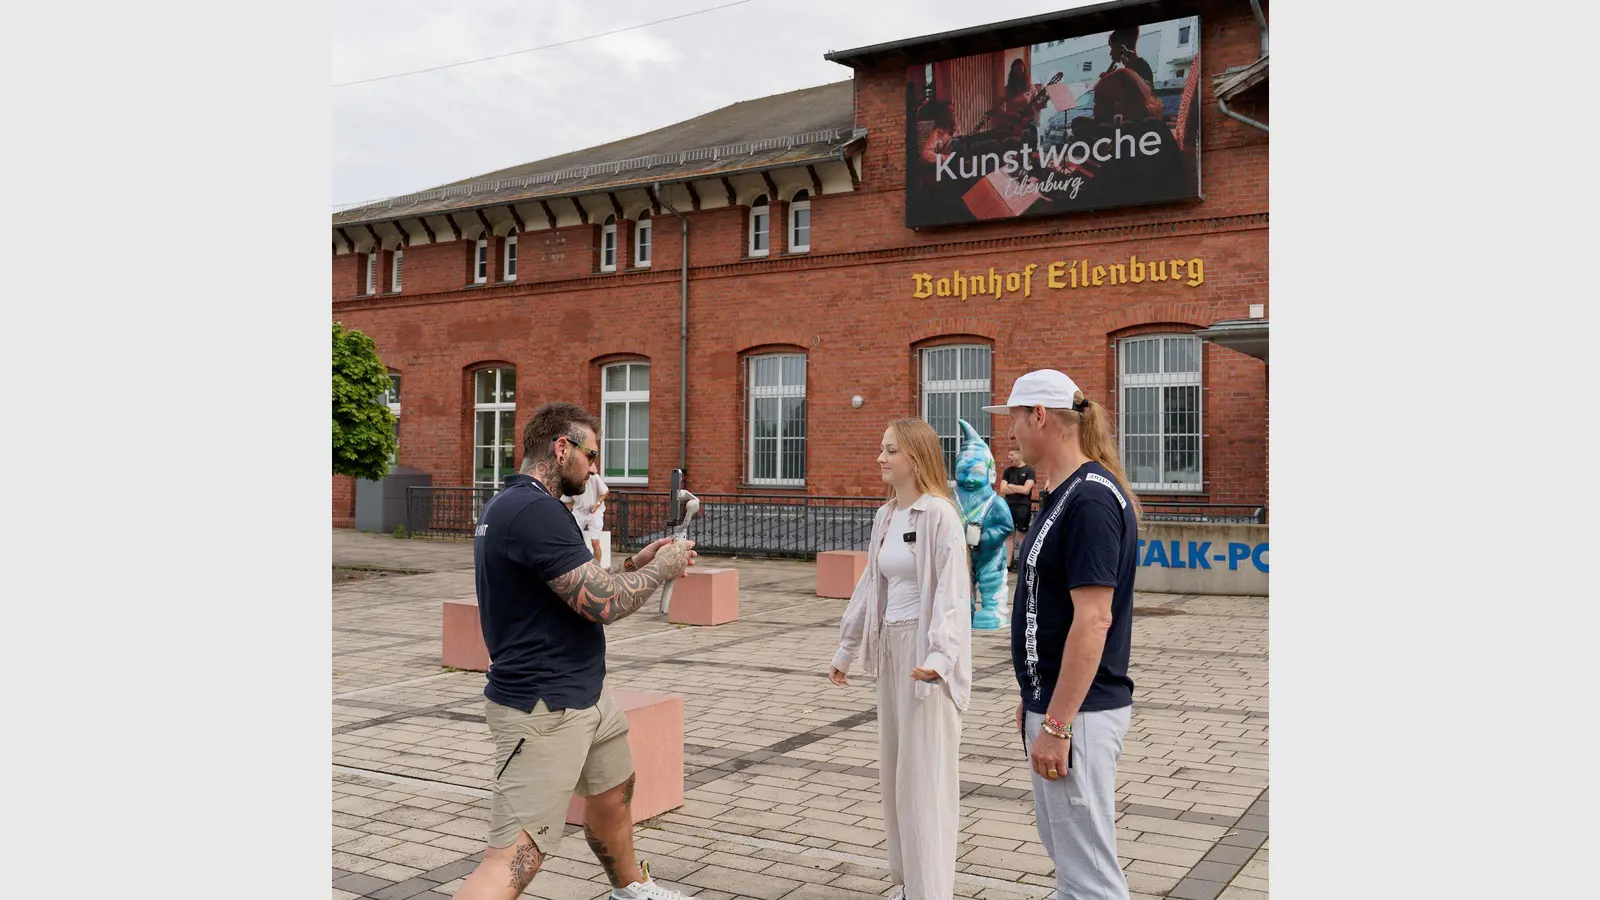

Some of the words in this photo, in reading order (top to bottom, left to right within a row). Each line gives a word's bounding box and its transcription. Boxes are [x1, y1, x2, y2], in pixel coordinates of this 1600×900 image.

[934, 128, 1163, 182] Kunstwoche
[1002, 172, 1085, 200] Eilenburg
[911, 263, 1038, 302] Bahnhof
[1047, 255, 1206, 289] Eilenburg
[1026, 616, 1036, 659] TanzKultur
